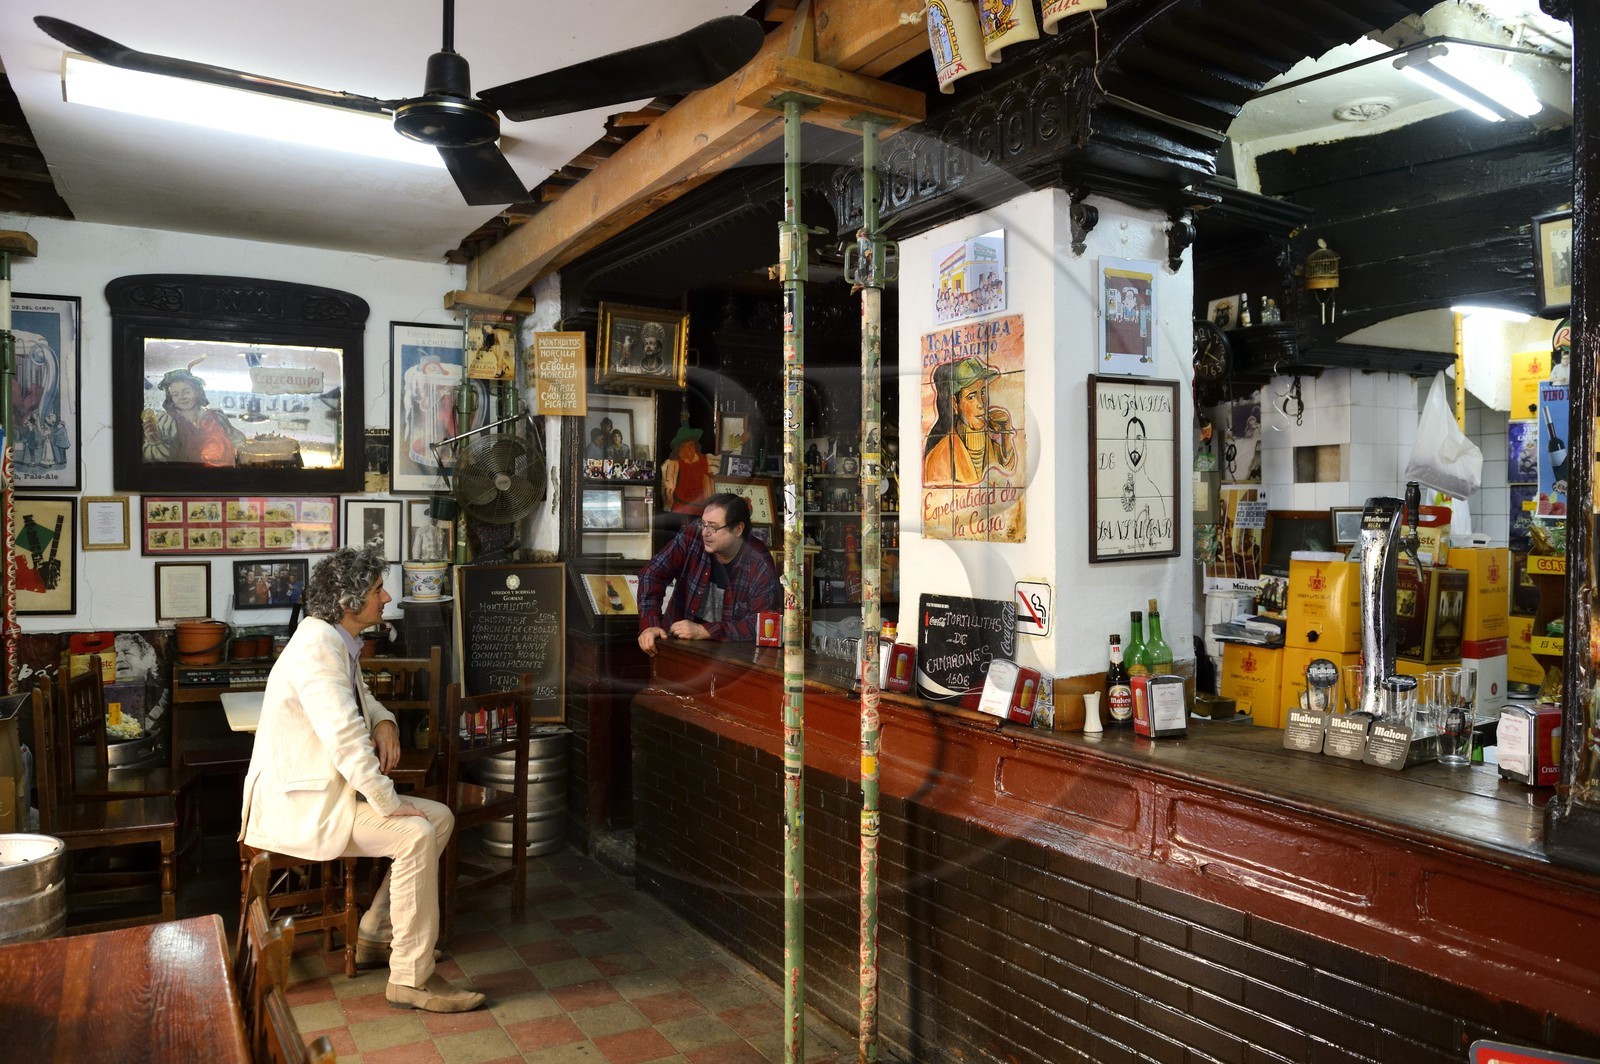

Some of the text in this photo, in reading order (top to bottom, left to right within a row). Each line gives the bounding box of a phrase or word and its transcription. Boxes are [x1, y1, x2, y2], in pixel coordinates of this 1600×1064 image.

[540, 350, 575, 358] MORCILLA
[540, 363, 575, 371] CEBOLLA
[253, 373, 320, 387] Cruzcampo
[540, 370, 577, 379] MORCILLA
[548, 384, 575, 392] ARROZ
[541, 391, 576, 401] CHORIZO
[1543, 390, 1565, 402] VINO
[545, 400, 577, 409] PICANTE
[1098, 450, 1116, 471] DE
[924, 480, 1017, 525] Especialidad de
[953, 510, 1006, 537] la Casa
[1363, 515, 1390, 523] Mahou
[953, 632, 968, 646] DE
[1540, 641, 1564, 652] El Seg
[1290, 712, 1321, 725] Mahou
[1331, 717, 1363, 731] Mahou
[1374, 726, 1408, 741] Mahou
[1541, 766, 1560, 774] Cruzc
